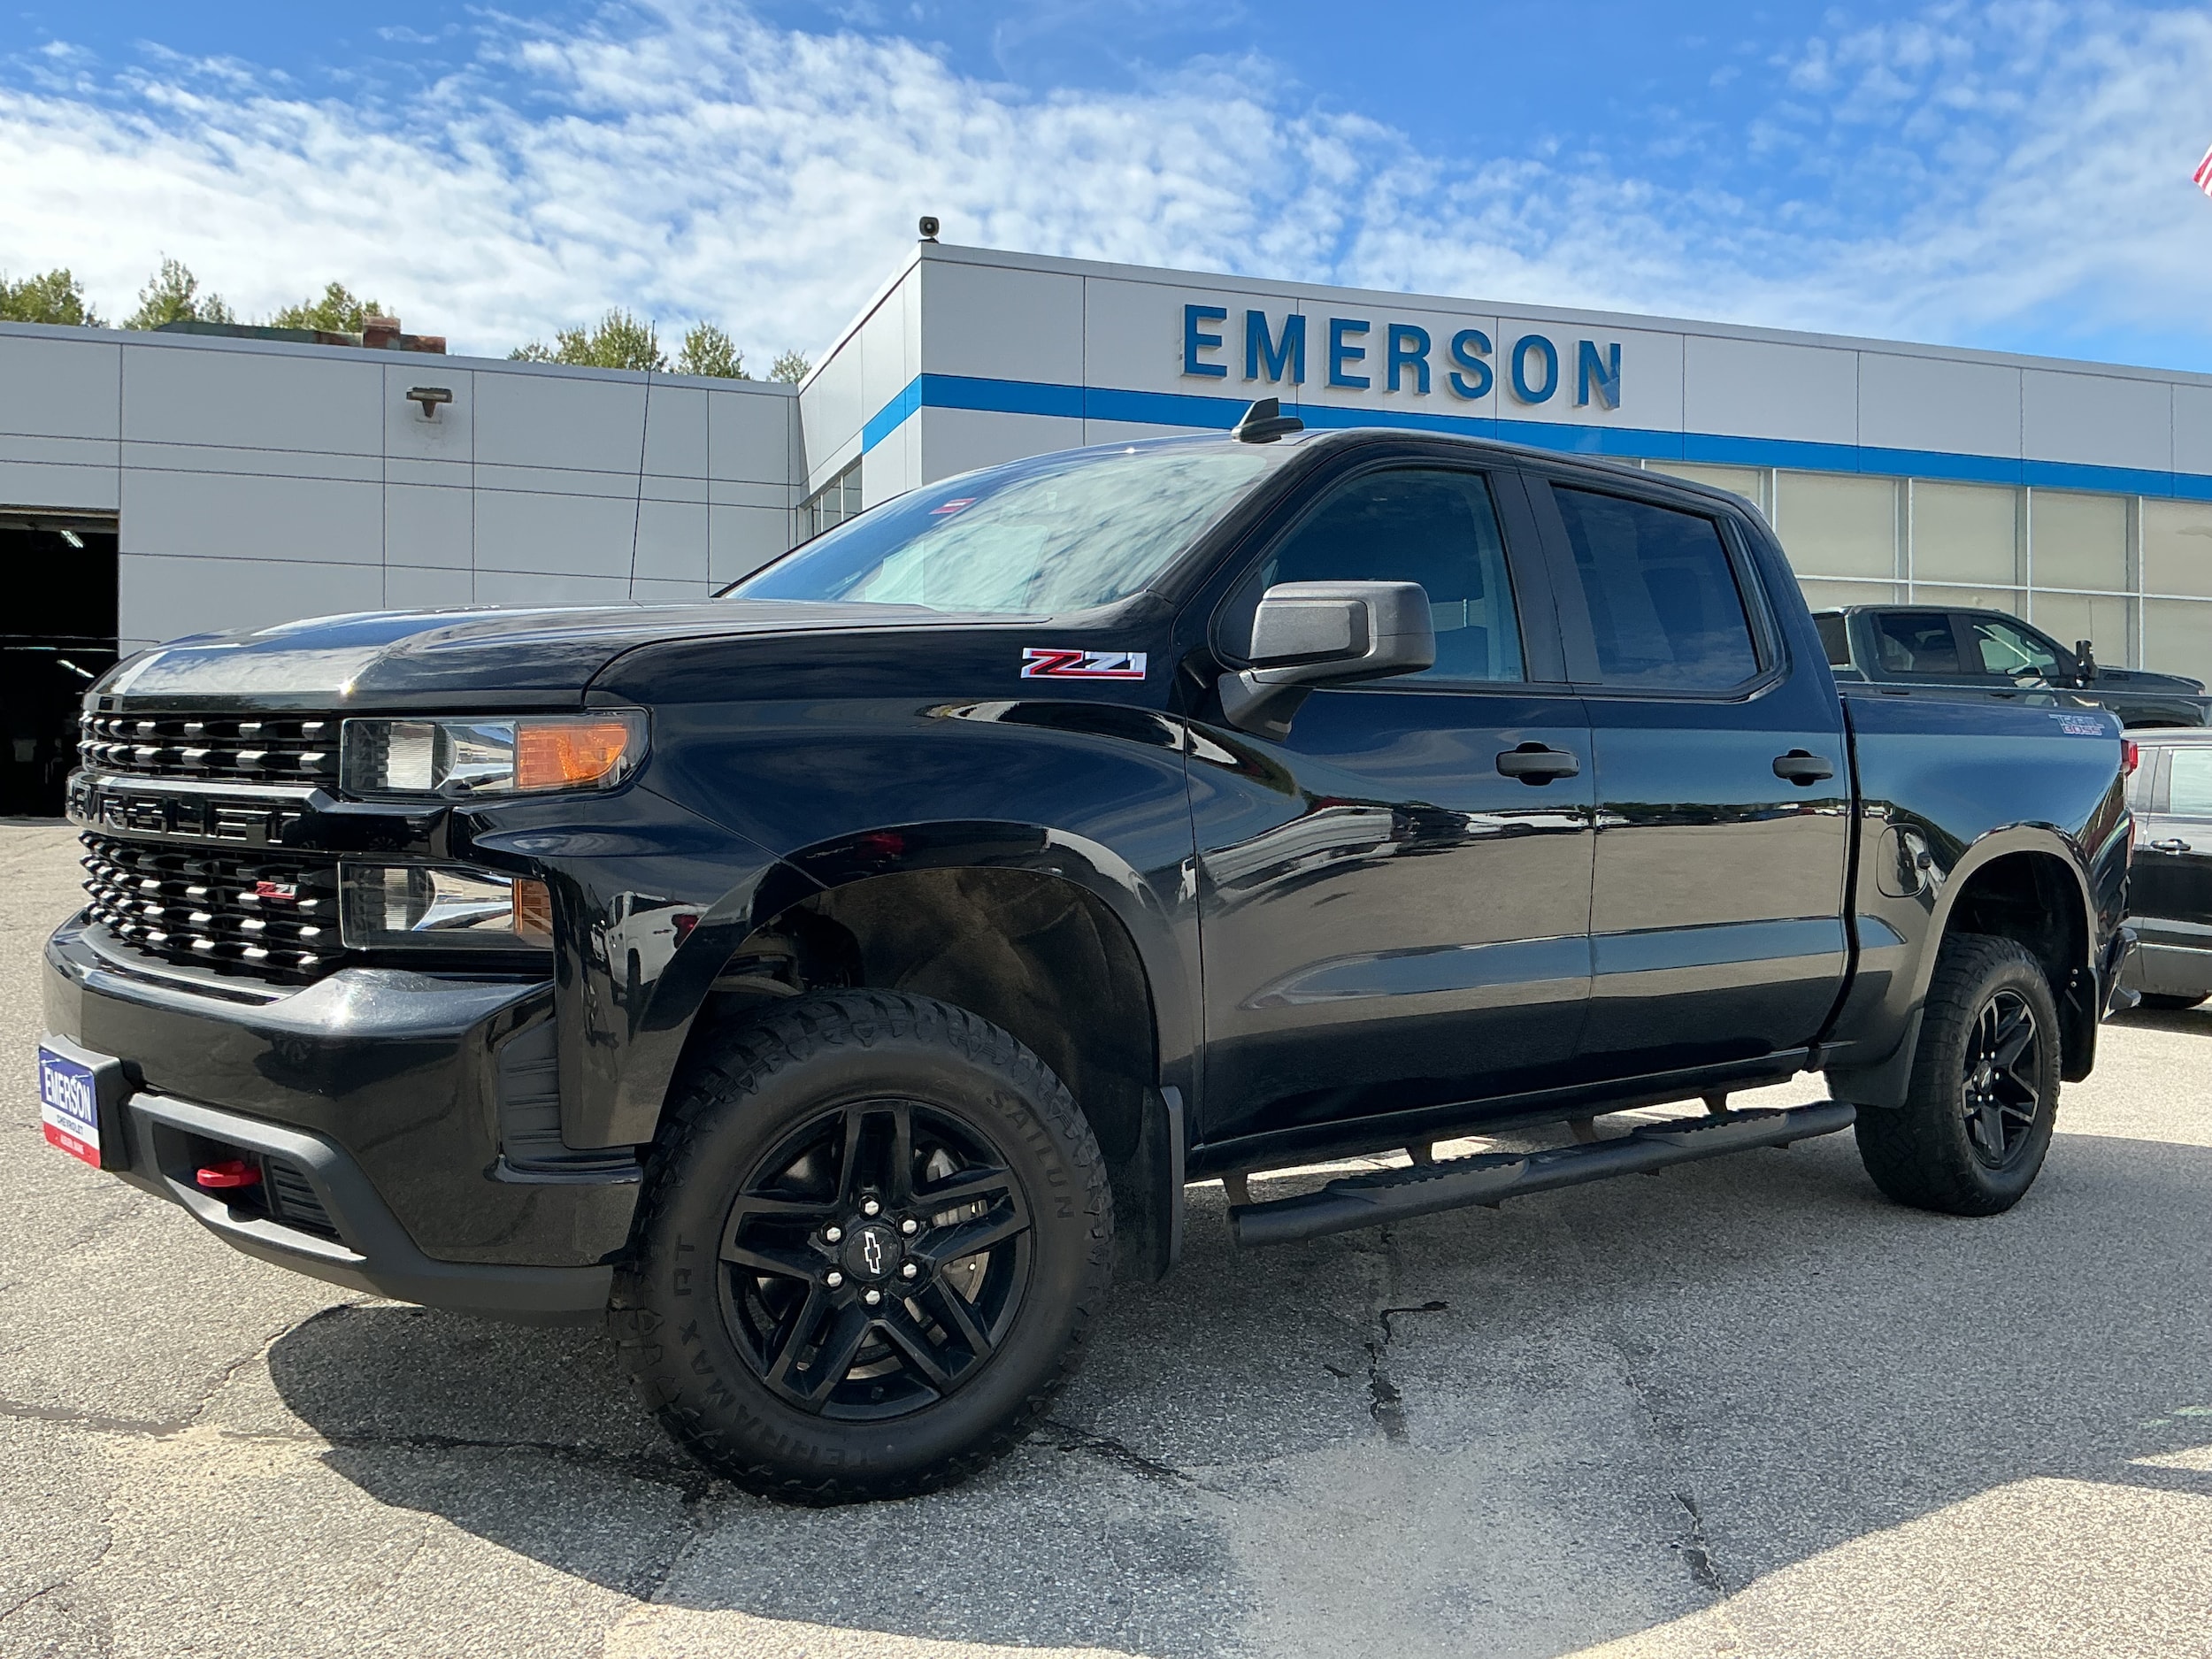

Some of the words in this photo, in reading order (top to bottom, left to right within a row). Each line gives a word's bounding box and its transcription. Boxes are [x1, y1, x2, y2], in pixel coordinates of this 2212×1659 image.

[1181, 303, 1622, 411] EMERSON
[1021, 648, 1147, 680] Z71
[2062, 726, 2102, 736] BOSS
[44, 1066, 92, 1122] EMERSON
[986, 1089, 1076, 1219] SAILUN
[673, 1234, 695, 1297] RT
